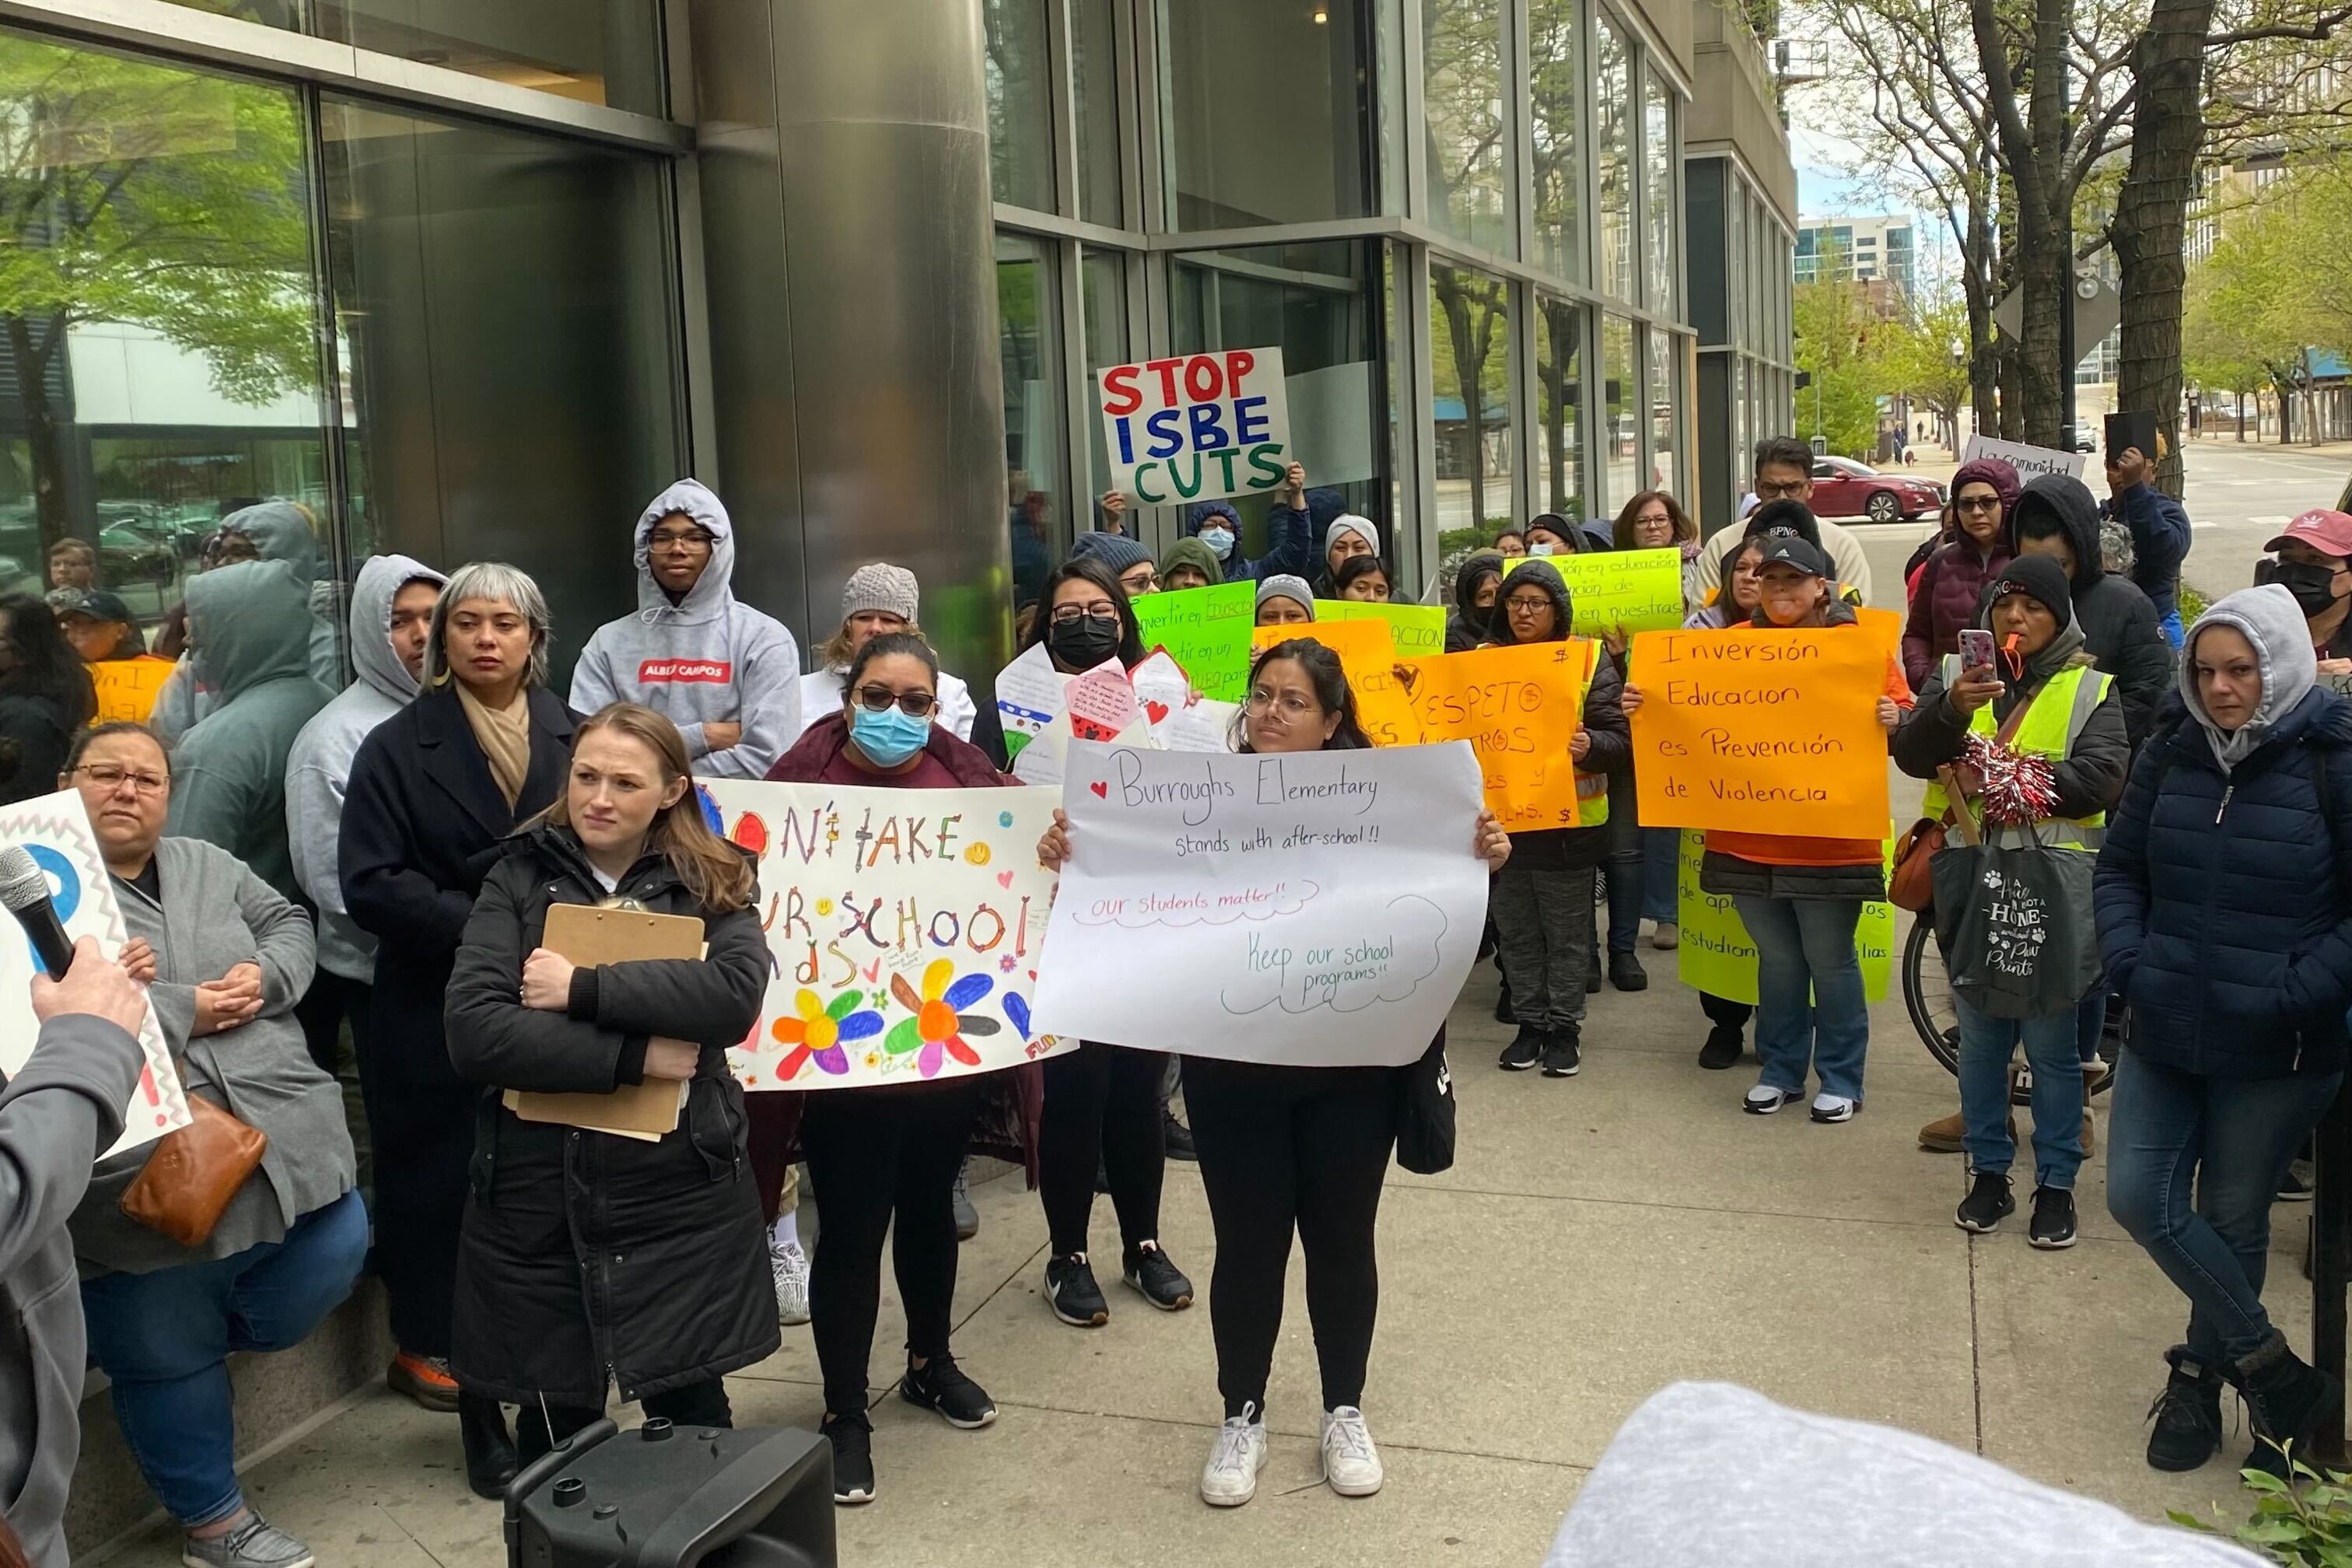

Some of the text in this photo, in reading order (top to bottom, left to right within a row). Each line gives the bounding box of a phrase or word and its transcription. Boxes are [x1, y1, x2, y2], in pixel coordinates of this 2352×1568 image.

[1103, 351, 1254, 415] STOP
[1115, 396, 1270, 464] ISBE
[1135, 443, 1285, 502] CUTS
[1587, 563, 1605, 576] en
[1614, 578, 1633, 592] de
[1139, 597, 1184, 640] nvertir
[1188, 611, 1201, 628] en
[1580, 594, 1683, 624] en nuestras
[1391, 626, 1444, 646] ACION
[1659, 634, 1818, 663] Inversión
[1199, 647, 1212, 662] en
[1216, 642, 1231, 660] un
[1667, 680, 1800, 707] Educacion
[1658, 727, 1843, 758] es Prevención
[1109, 748, 1235, 826] Burroughs
[1256, 758, 1379, 815] Elementary
[1664, 776, 1828, 803] de Violencia
[1241, 824, 1273, 852] with
[1139, 887, 1209, 915] students
[1679, 880, 1694, 901] de
[1866, 905, 1886, 919] os
[1682, 927, 1755, 957] estudian
[2010, 941, 2041, 960] Paw
[1248, 931, 1395, 988] Keep our school
[1986, 950, 2034, 976] Prints
